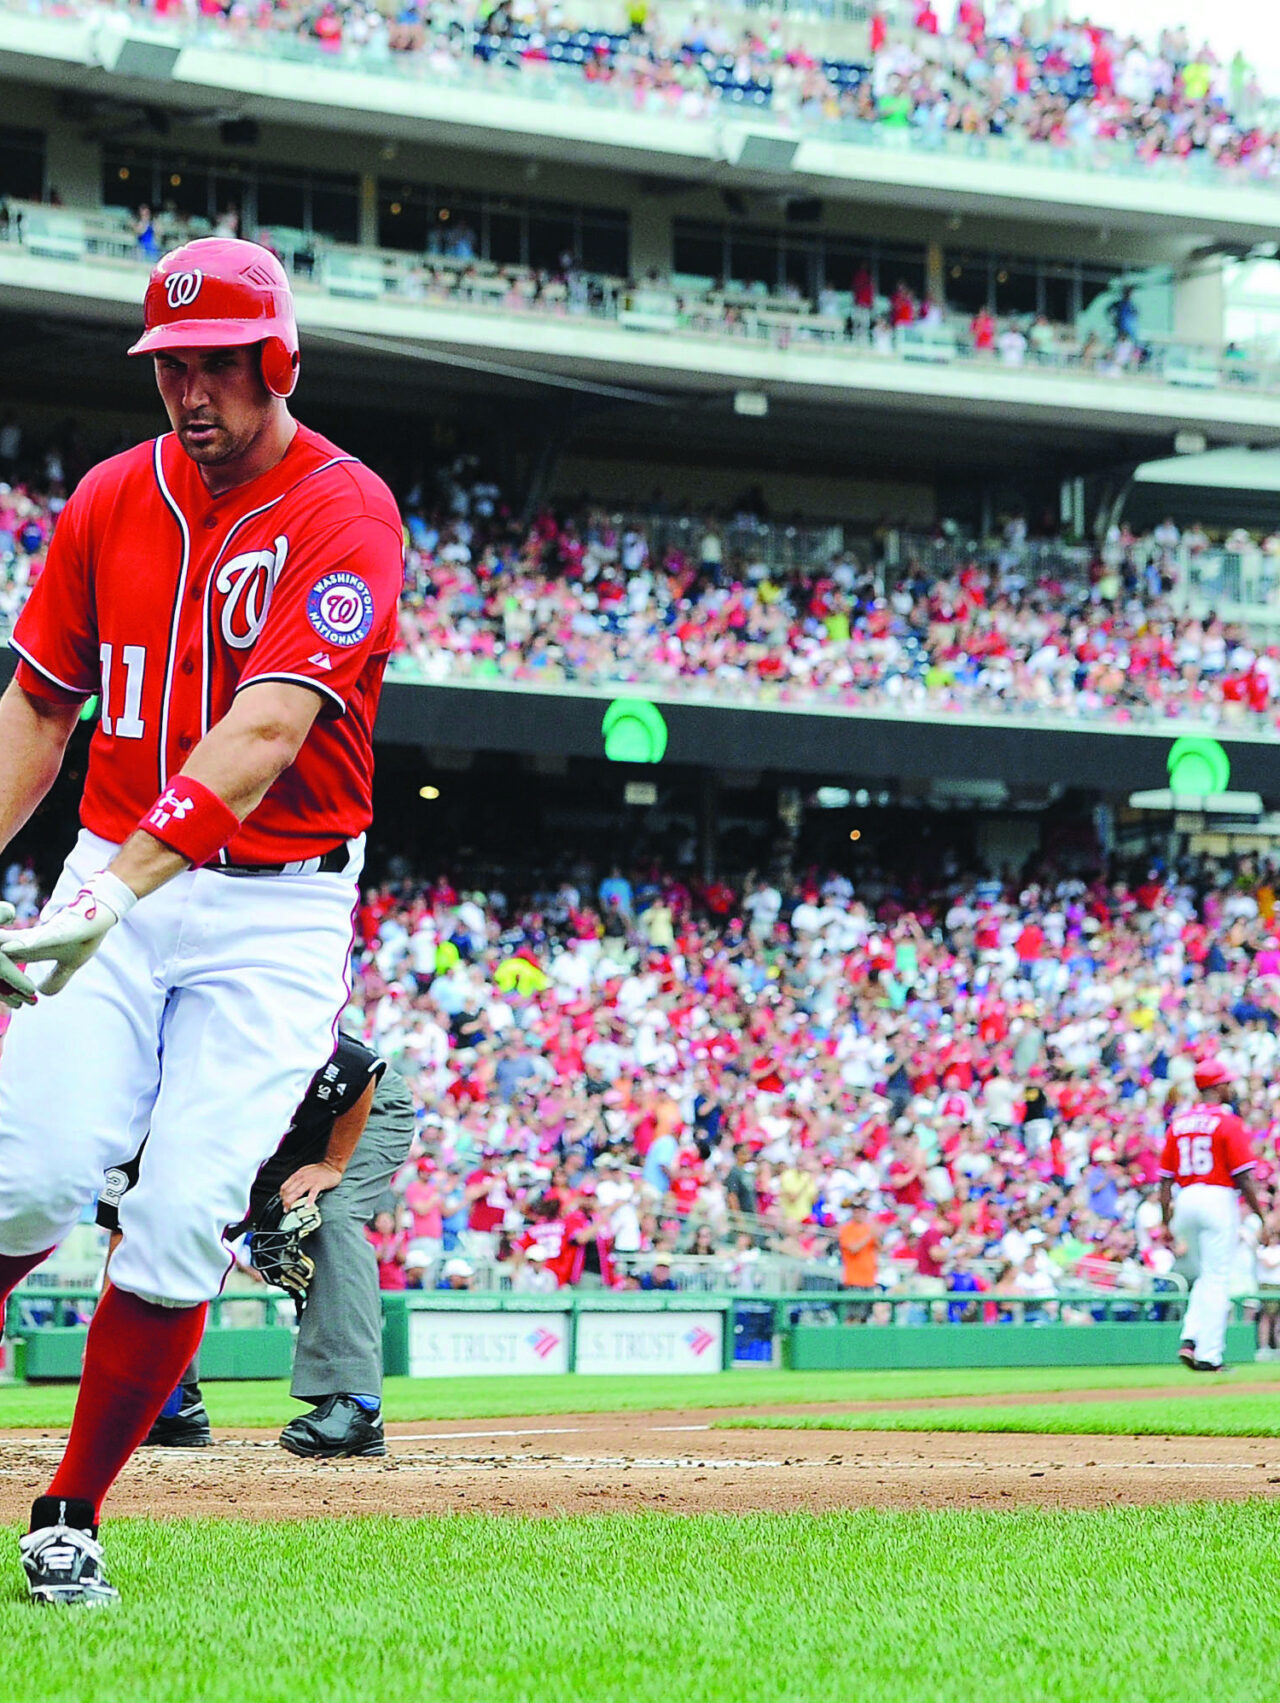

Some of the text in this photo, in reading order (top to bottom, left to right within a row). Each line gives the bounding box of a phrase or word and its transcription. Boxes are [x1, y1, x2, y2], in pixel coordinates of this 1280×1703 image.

[164, 268, 203, 309] W
[216, 535, 289, 649] W
[313, 573, 373, 614] WASHINGTON
[327, 595, 359, 624] W
[309, 611, 365, 645] NATIONALS
[99, 642, 147, 739] 11
[149, 808, 171, 829] 11
[1176, 1135, 1214, 1177] 16
[449, 1333, 519, 1362] TRUST
[613, 1331, 679, 1361] TRUST
